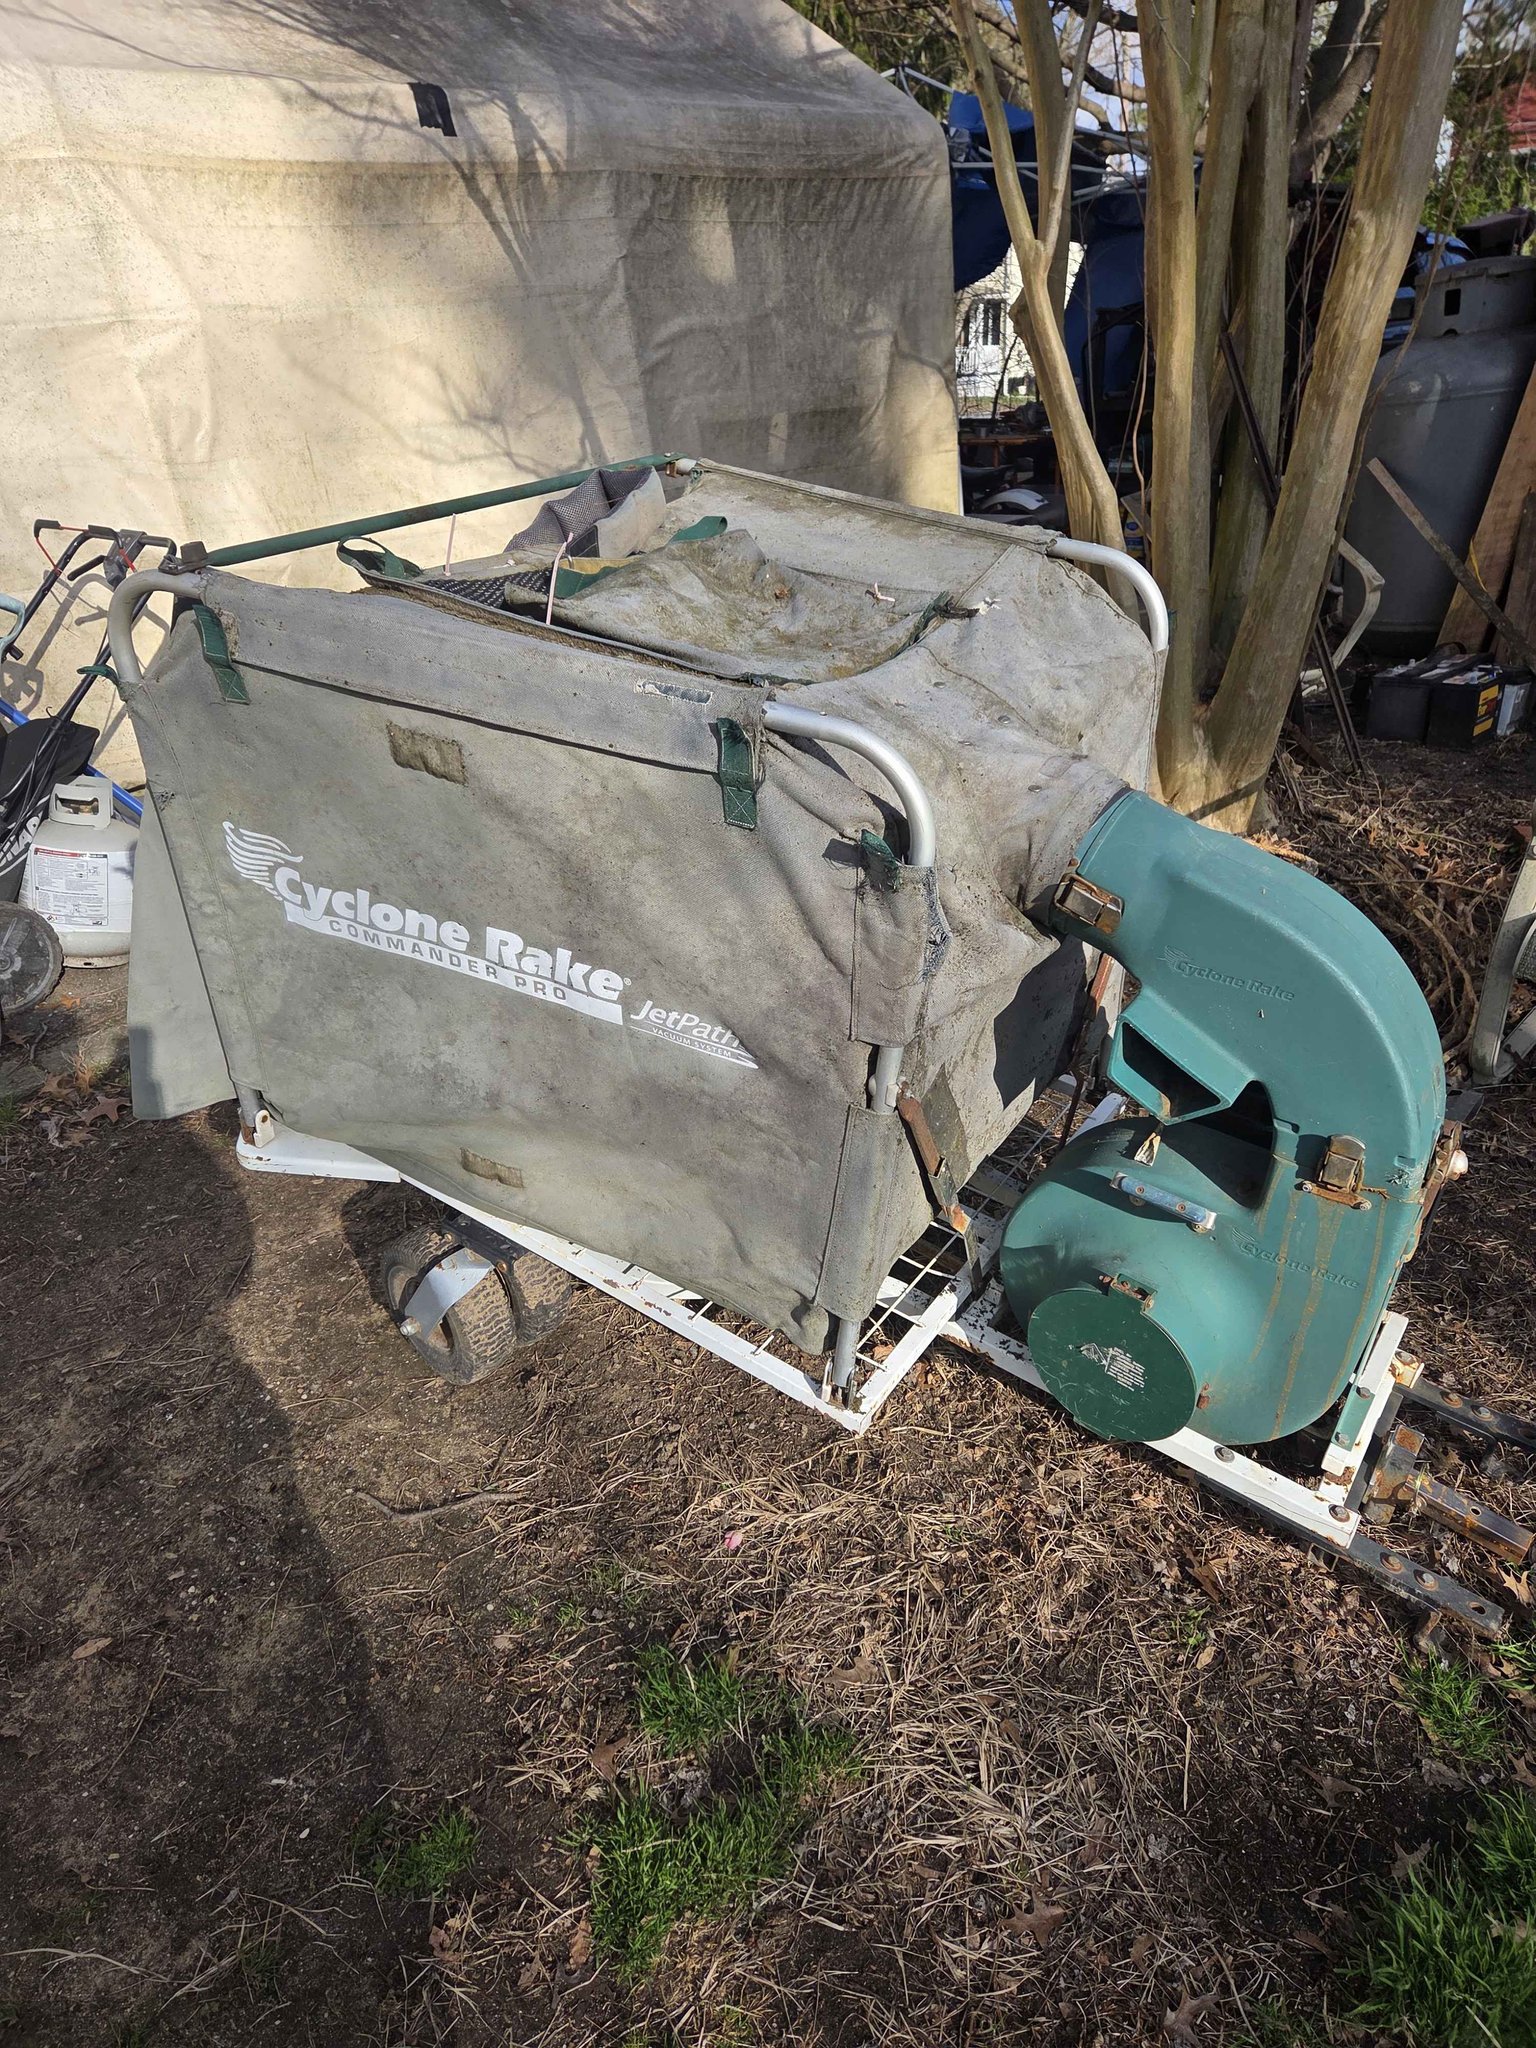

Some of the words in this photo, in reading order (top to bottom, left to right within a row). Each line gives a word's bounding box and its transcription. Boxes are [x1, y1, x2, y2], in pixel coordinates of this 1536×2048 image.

[274, 866, 470, 952] Cyclone
[329, 919, 498, 980] COMMANDER
[514, 974, 567, 1001] PRO
[1173, 960, 1245, 989] Cyclone
[1247, 979, 1295, 1002] Rake
[630, 1000, 740, 1048] JetPath
[652, 1027, 691, 1046] VACUUM
[694, 1041, 732, 1058] SYSTEM
